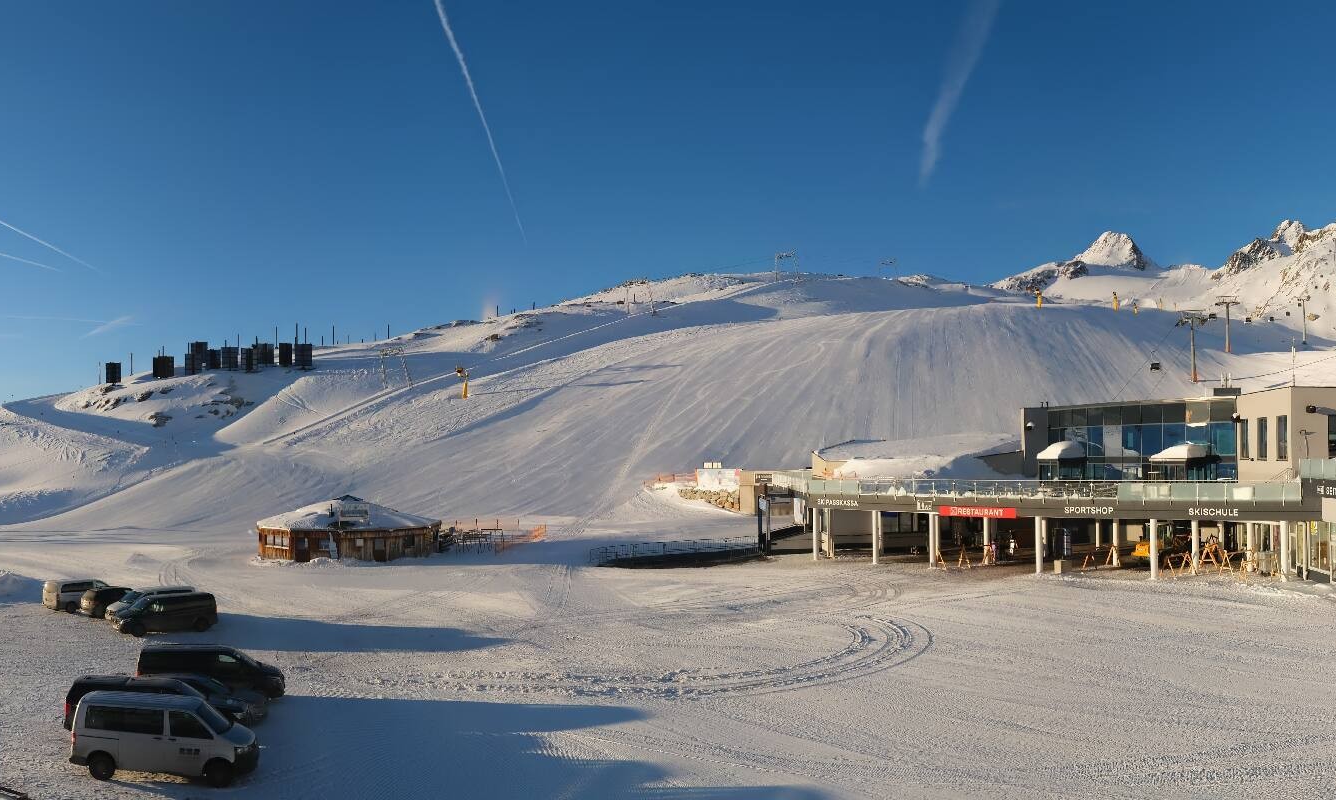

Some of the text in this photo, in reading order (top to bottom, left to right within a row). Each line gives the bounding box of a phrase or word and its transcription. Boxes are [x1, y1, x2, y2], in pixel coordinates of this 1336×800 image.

[957, 507, 1004, 517] RESTAURANT
[1064, 506, 1114, 515] SPORTSHOP
[1188, 507, 1239, 517] SKISCHULE
